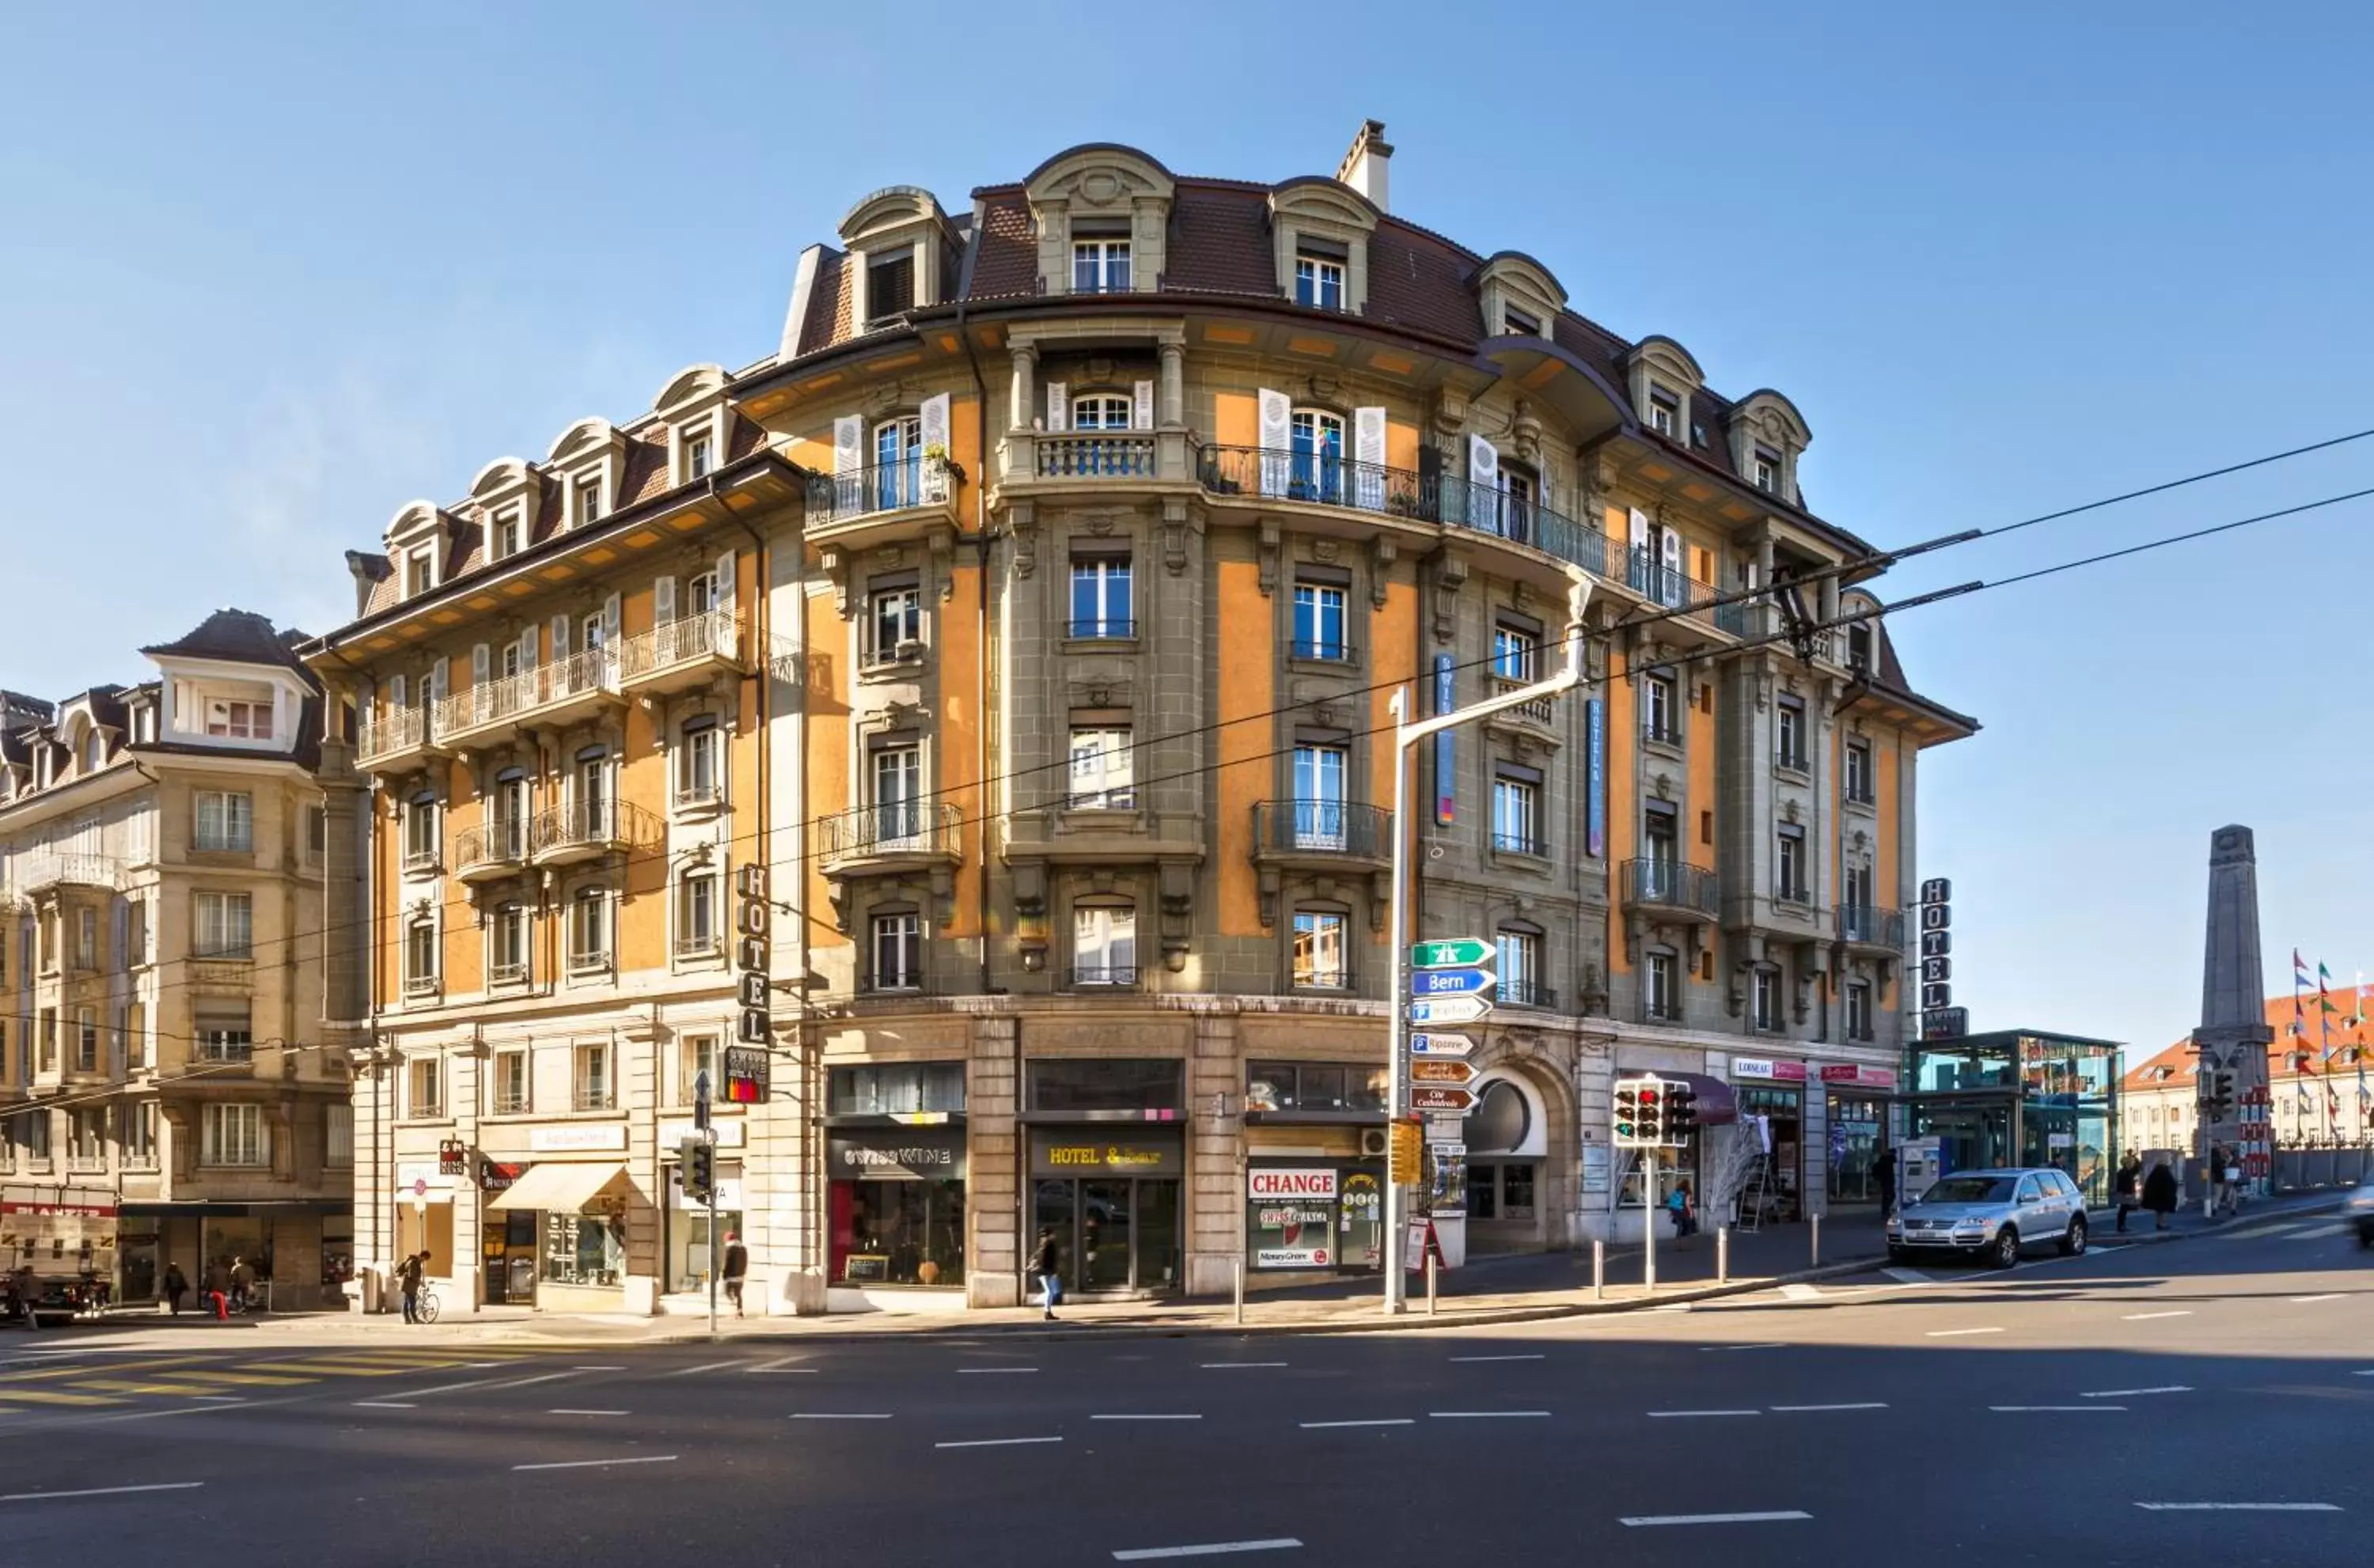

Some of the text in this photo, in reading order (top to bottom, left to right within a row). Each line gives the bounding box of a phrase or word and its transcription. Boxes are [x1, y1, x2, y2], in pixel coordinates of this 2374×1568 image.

[1926, 881, 1943, 1007] HOTEL
[749, 868, 764, 1042] HOTEL
[1428, 974, 1464, 990] Bern
[899, 1148, 950, 1164] WINE
[1050, 1147, 1100, 1164] HOTEL
[1106, 1146, 1120, 1164] &
[1253, 1174, 1333, 1193] CHANGE
